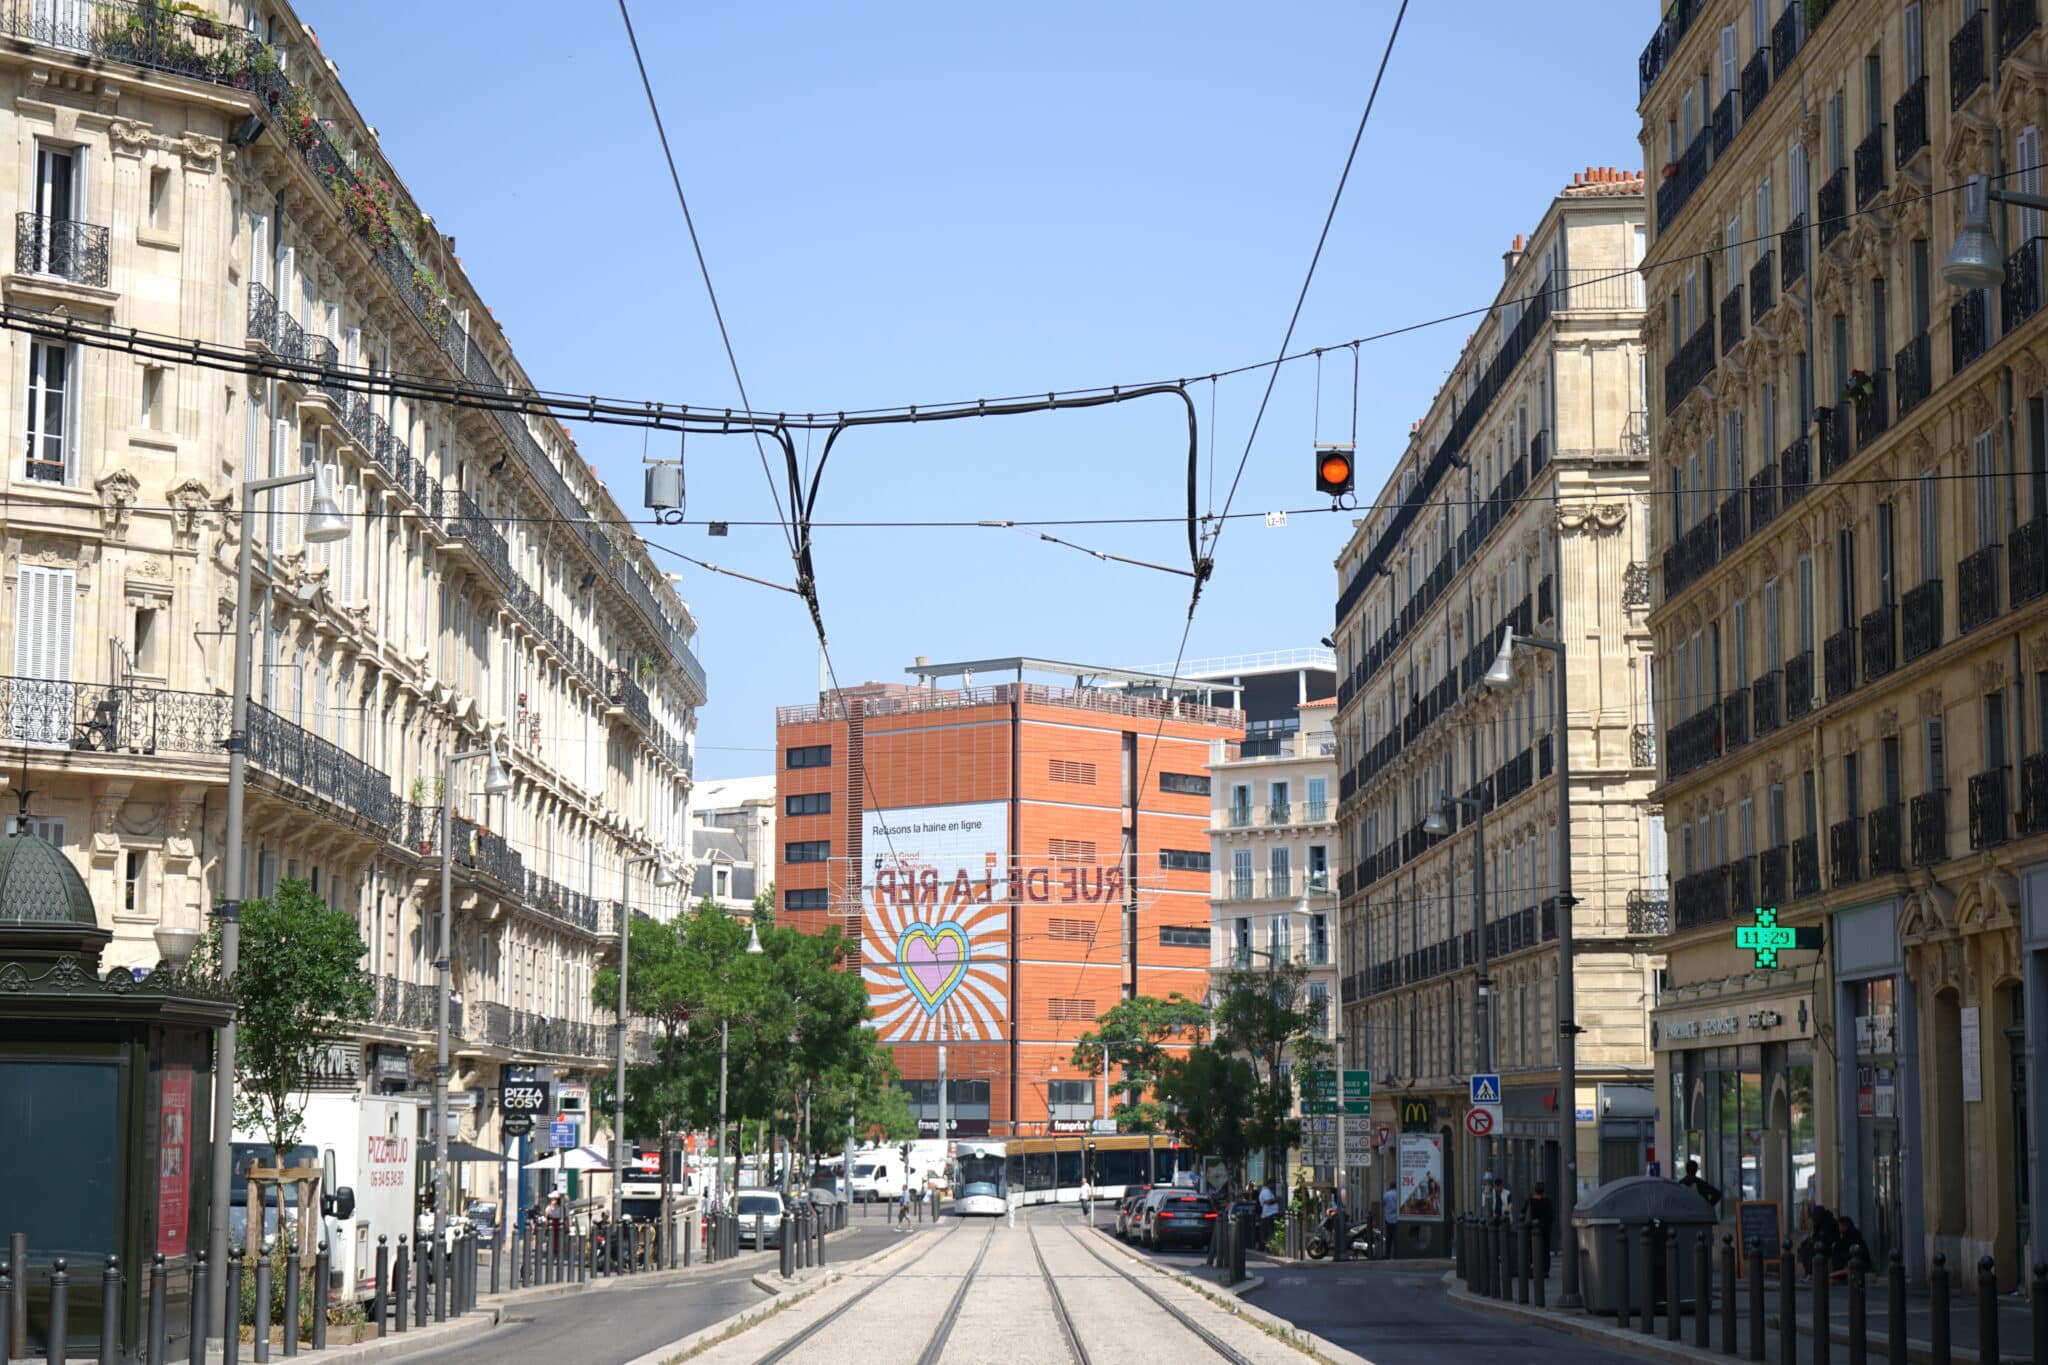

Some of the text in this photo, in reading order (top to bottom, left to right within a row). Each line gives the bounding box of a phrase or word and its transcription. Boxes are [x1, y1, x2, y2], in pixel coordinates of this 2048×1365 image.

[872, 819, 983, 836] Refusons la haine en ligne
[1743, 931, 1790, 945] 11:29
[504, 1087, 543, 1098] PIZZA
[504, 1097, 543, 1109] COSY
[1054, 1119, 1085, 1132] franprix
